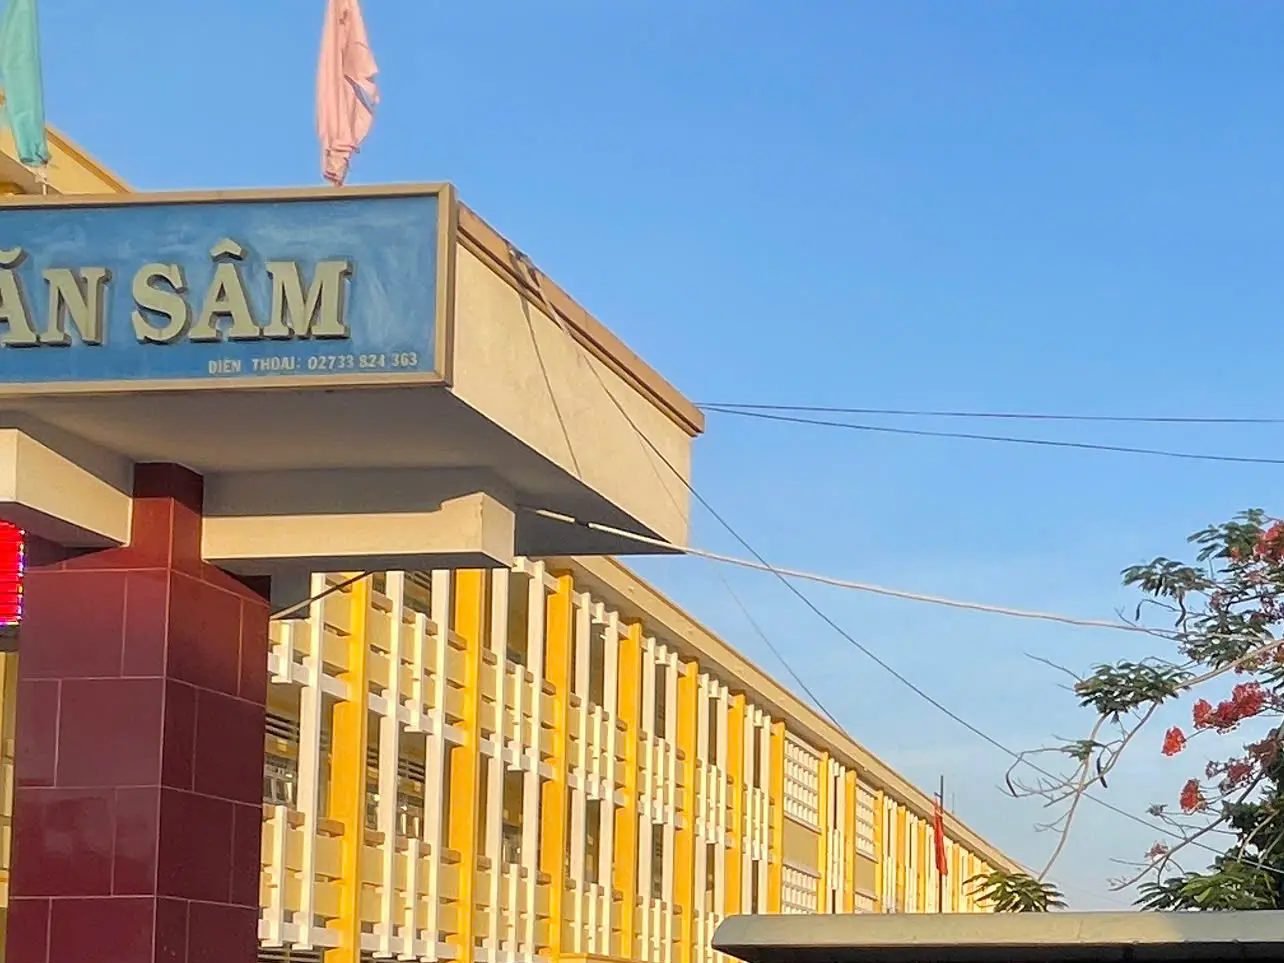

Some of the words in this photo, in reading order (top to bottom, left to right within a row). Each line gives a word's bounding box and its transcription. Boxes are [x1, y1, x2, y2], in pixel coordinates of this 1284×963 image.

[131, 238, 352, 346] SÂM
[308, 354, 354, 370] 02733
[359, 352, 385, 368] 824
[392, 351, 418, 366] 363
